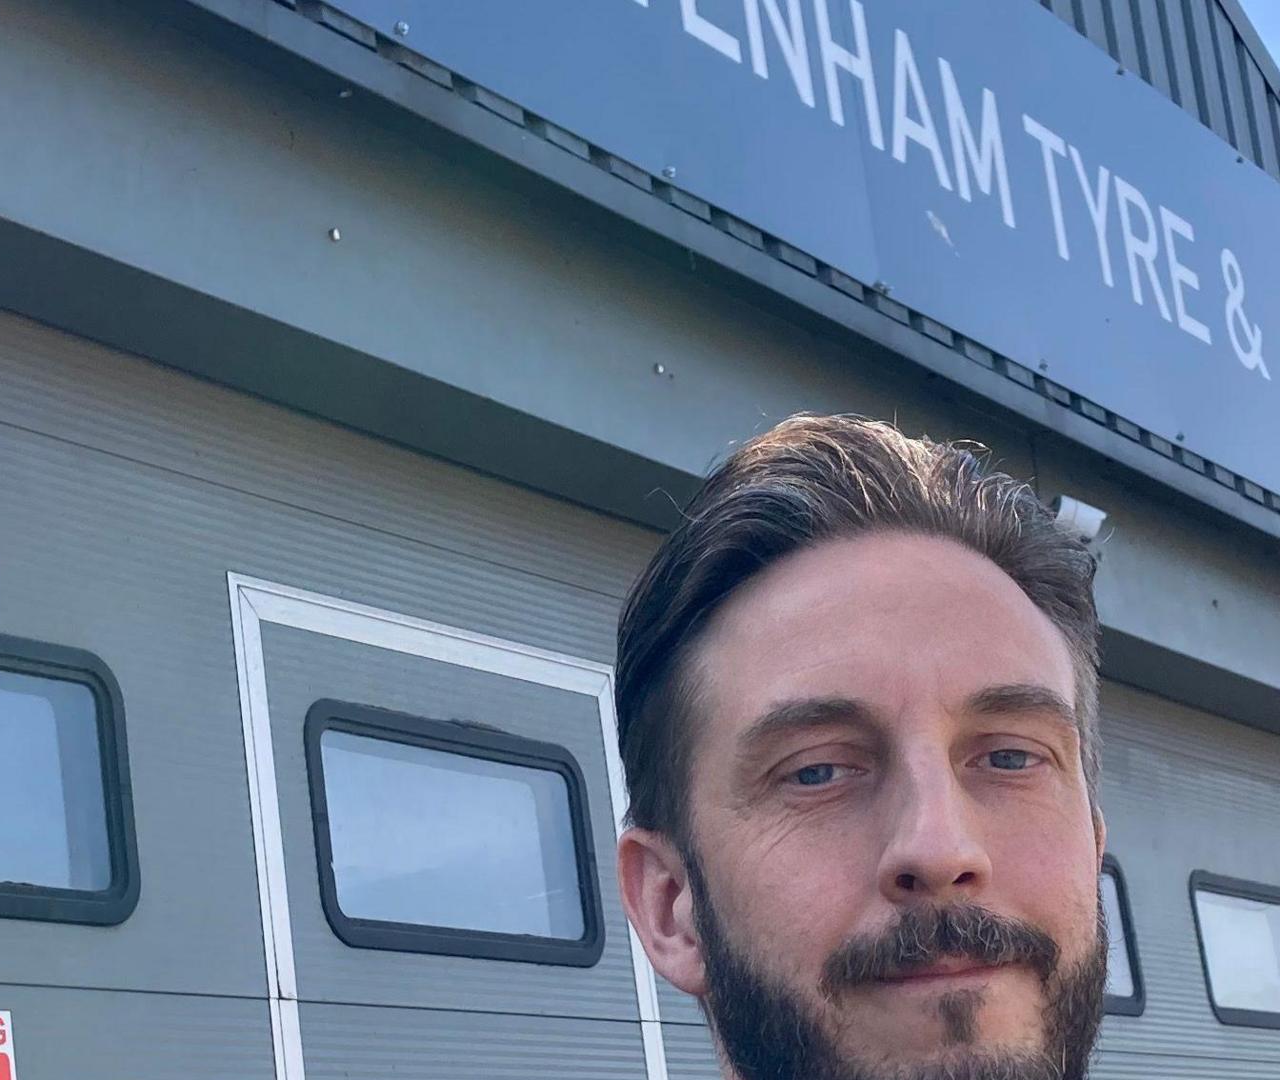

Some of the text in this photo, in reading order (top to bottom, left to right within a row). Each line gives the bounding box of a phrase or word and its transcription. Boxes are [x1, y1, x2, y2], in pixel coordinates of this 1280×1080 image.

[633, 0, 1016, 229] NHAM
[1023, 113, 1212, 345] TYRE
[1220, 248, 1272, 381] &
